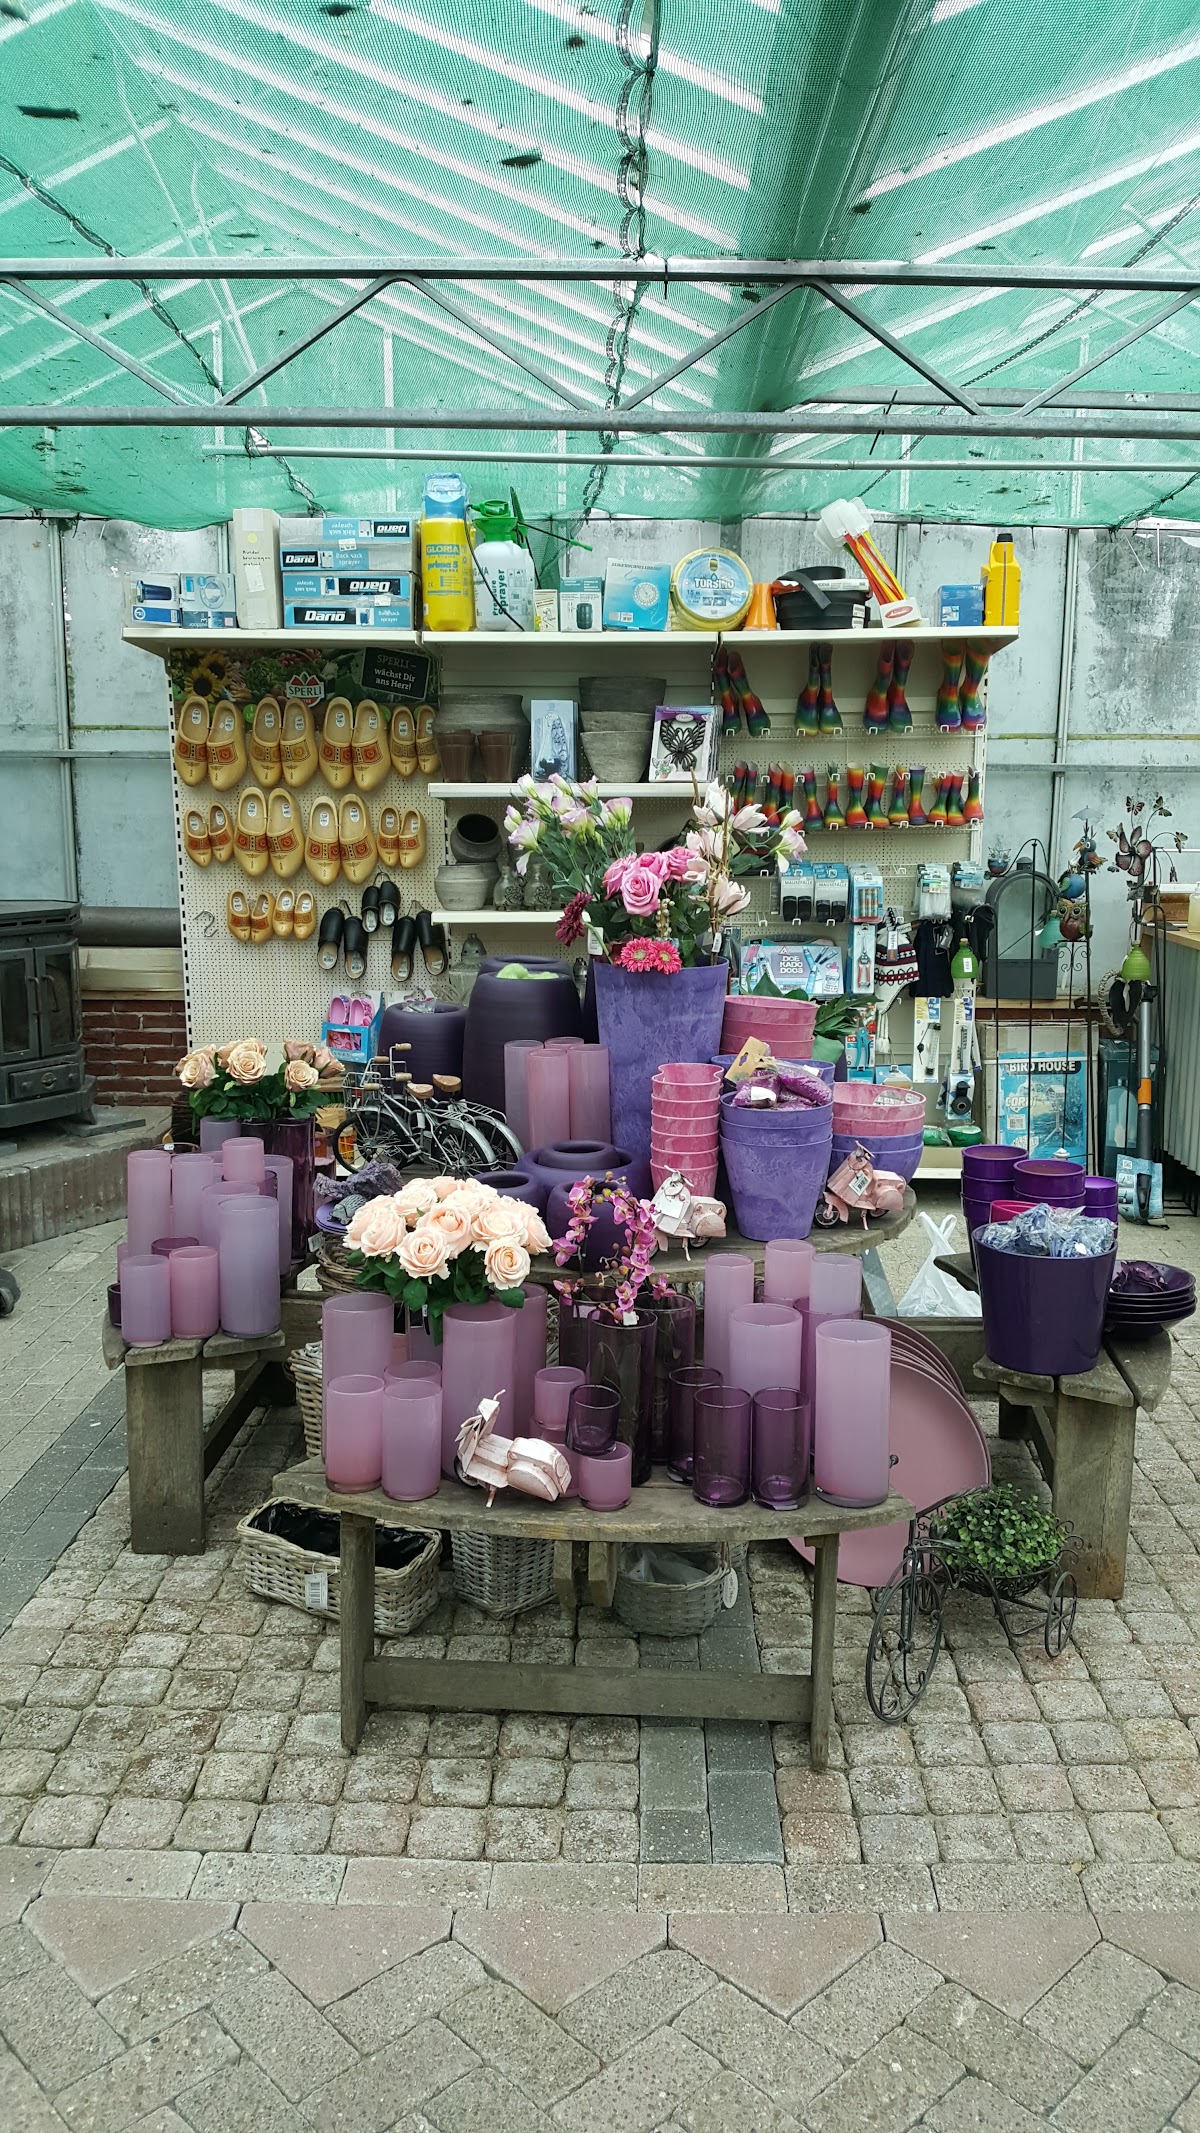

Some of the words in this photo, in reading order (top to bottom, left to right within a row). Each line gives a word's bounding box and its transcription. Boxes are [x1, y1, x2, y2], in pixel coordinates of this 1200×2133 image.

[427, 545, 459, 553] GLORIA
[285, 554, 315, 563] Dario
[428, 560, 451, 571] prime
[349, 581, 391, 592] Dario
[498, 569, 509, 615] Sprayer
[304, 610, 345, 621] Dario
[376, 654, 409, 669] SPERLI
[374, 668, 403, 680] wächst
[403, 672, 416, 683] Dir
[375, 678, 390, 687] ans
[390, 680, 412, 691] Herz!
[288, 685, 322, 697] SPERLI
[1009, 1062, 1035, 1072] BIRD
[1038, 1061, 1076, 1072] HOUSE
